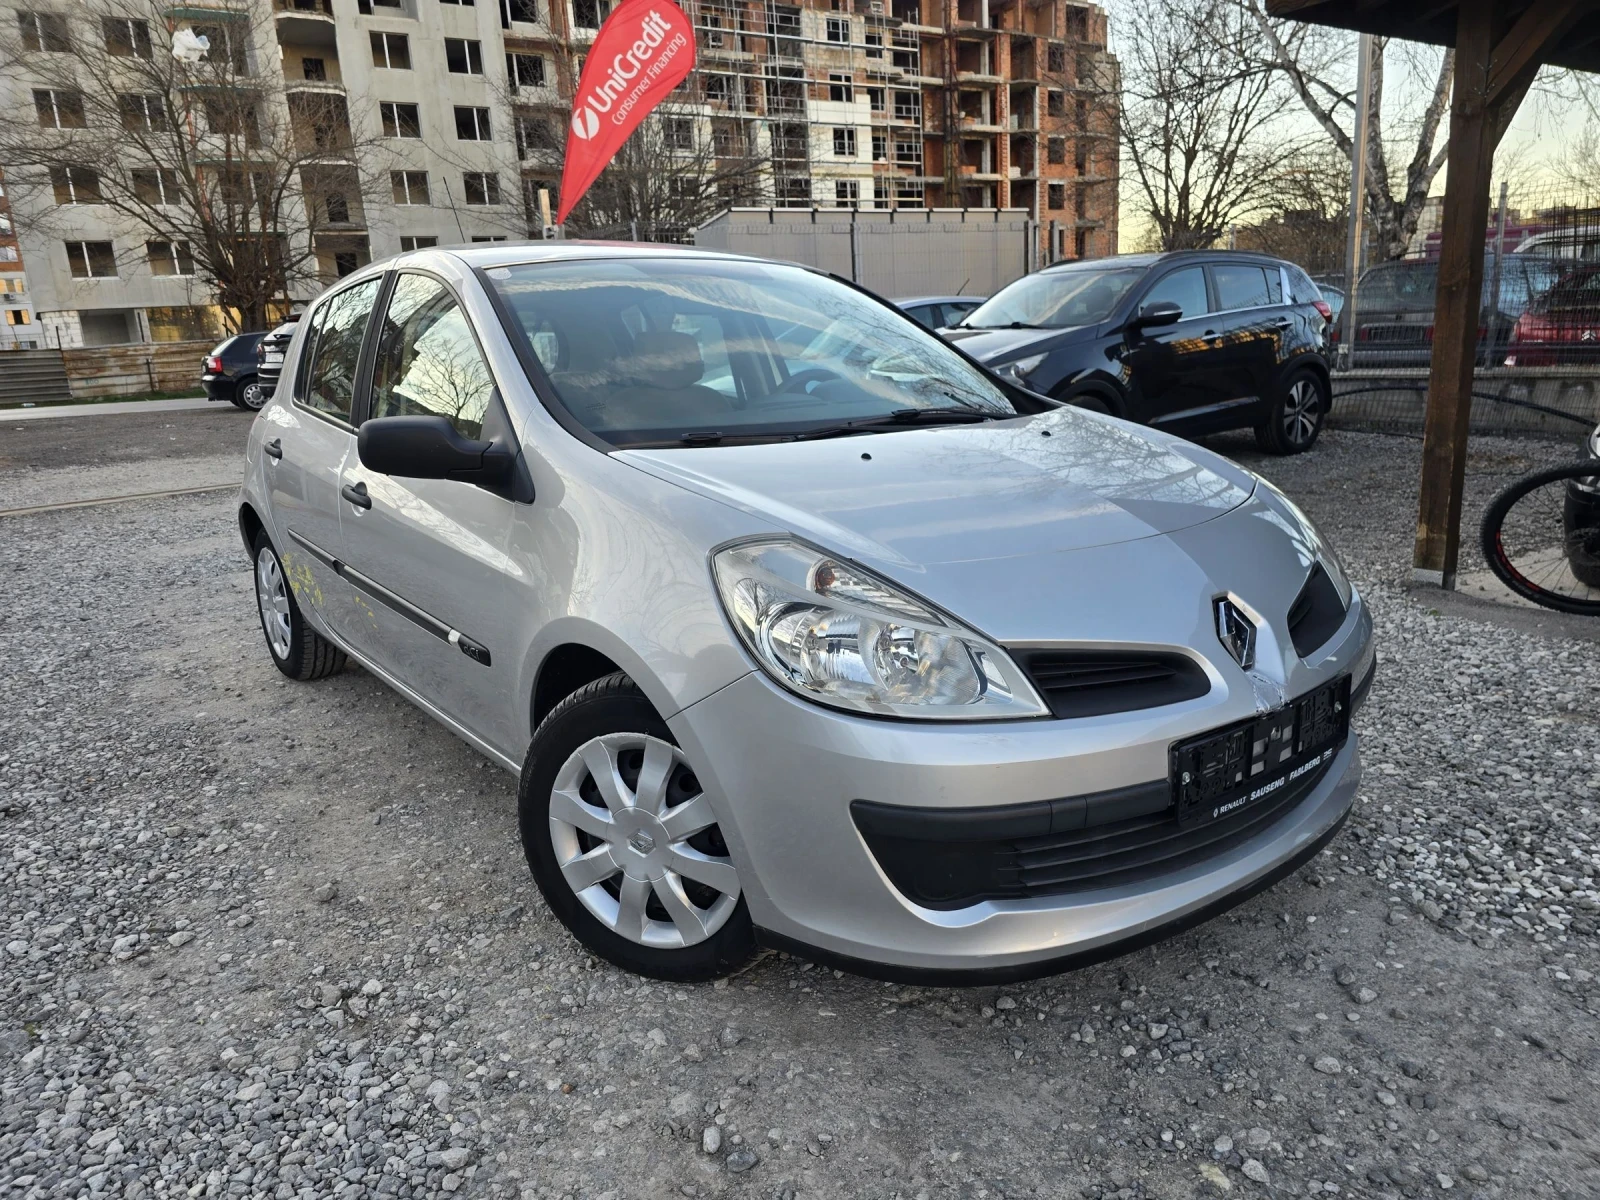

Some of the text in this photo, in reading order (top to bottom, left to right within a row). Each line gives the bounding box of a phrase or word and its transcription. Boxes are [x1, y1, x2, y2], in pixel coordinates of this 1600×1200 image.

[587, 9, 672, 113] UniCredit
[611, 32, 687, 126] Consumer Financing
[1219, 796, 1247, 814] RENAULT
[1250, 776, 1285, 801] SAUSENG
